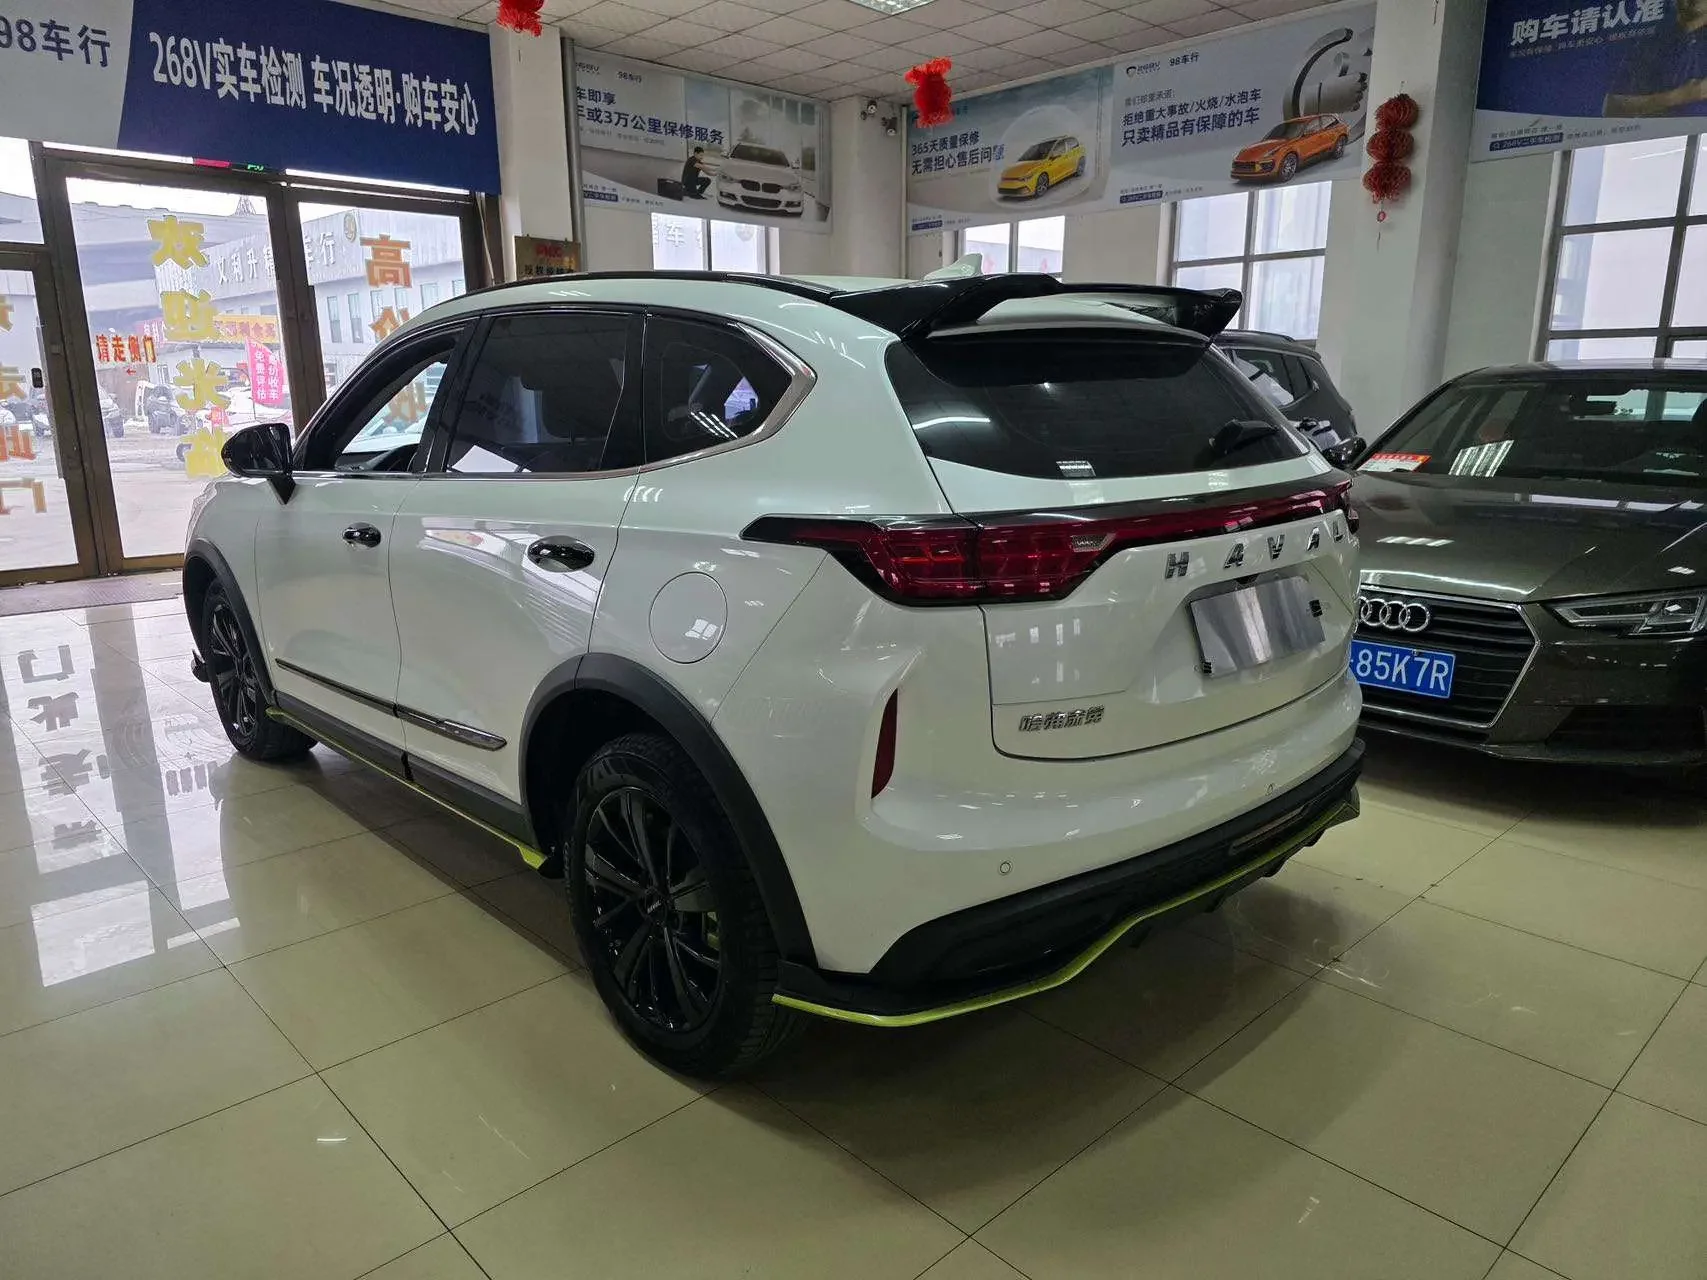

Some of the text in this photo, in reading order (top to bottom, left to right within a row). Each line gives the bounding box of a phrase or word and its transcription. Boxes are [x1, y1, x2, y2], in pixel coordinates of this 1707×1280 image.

[1511, 0, 1664, 46] 购车请认准
[149, 31, 307, 109] 268V实车检测
[1169, 52, 1199, 66] 98车行
[1122, 107, 1260, 147] 只卖精品有保障的车
[1123, 88, 1262, 127] 拒绝重大事故/火烧/水泡车
[912, 130, 979, 156] 365天质量保修
[95, 334, 157, 364] 请走侧门
[1165, 520, 1346, 579] HAVAL
[1356, 648, 1449, 691] 85K7R
